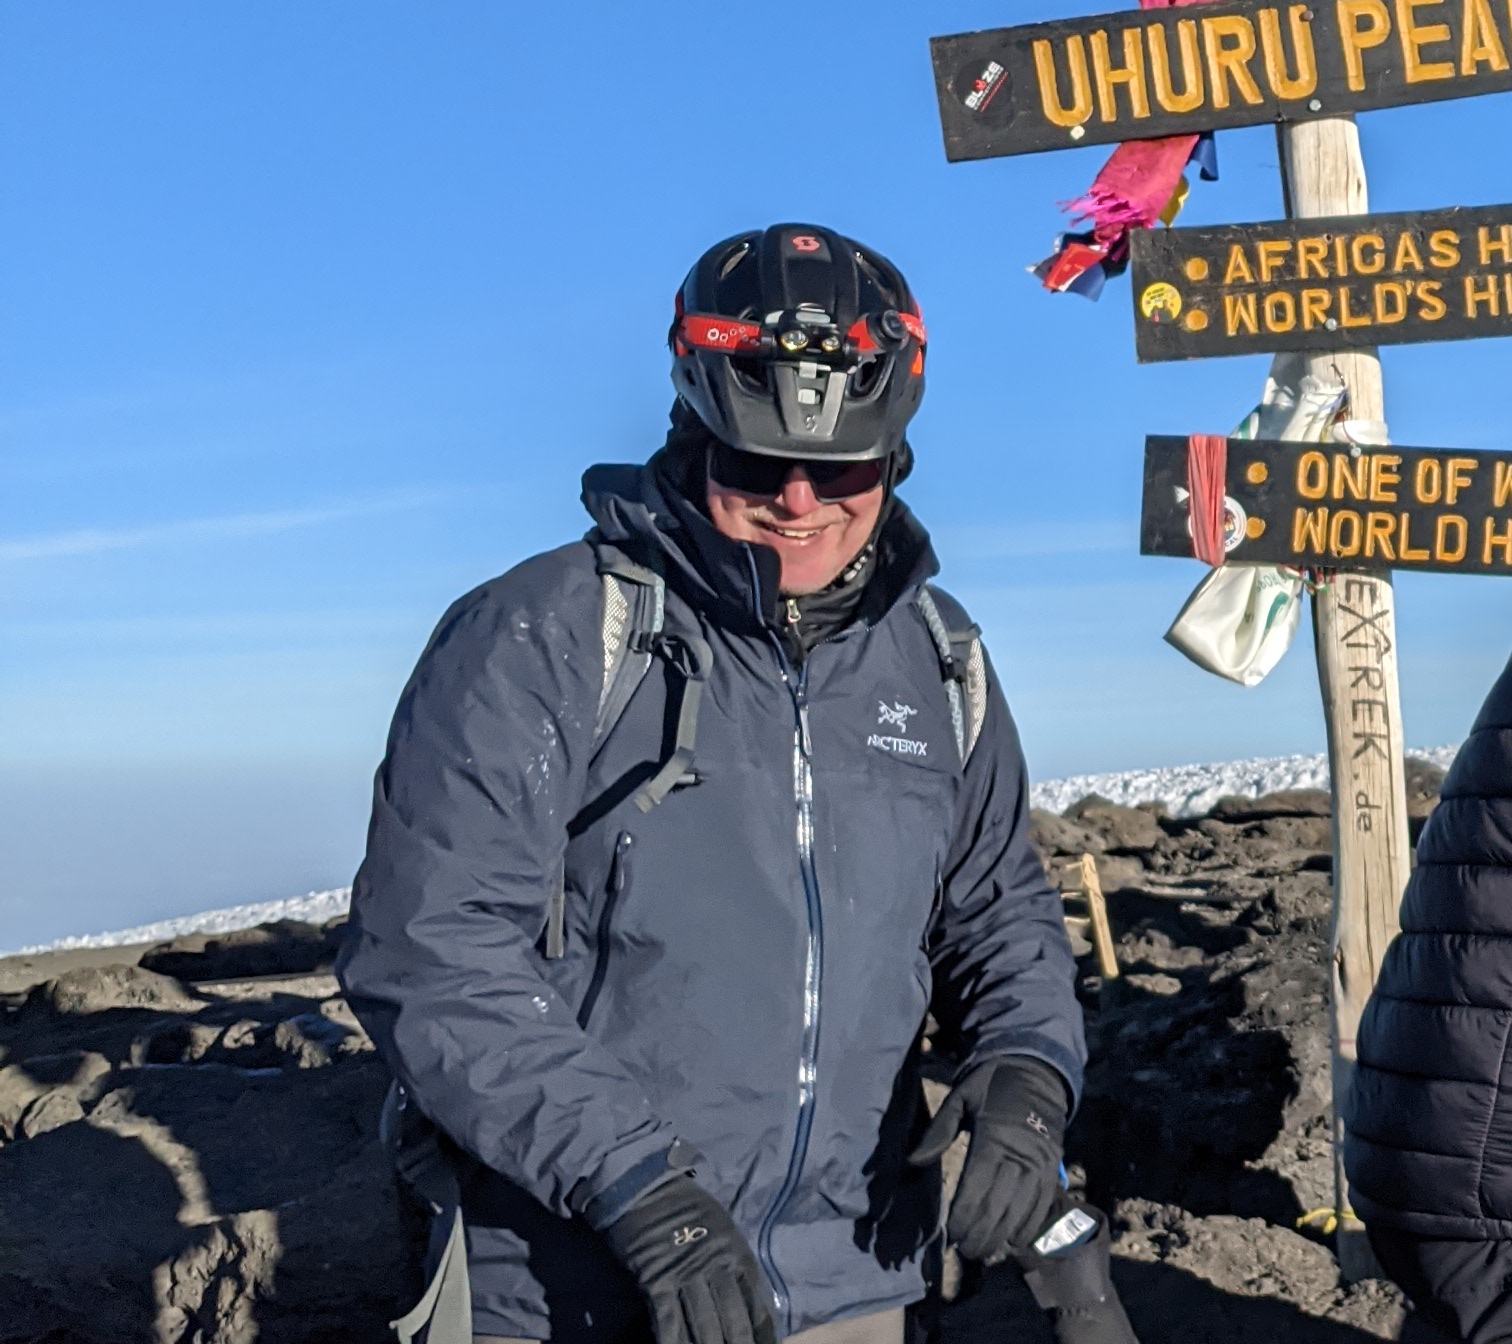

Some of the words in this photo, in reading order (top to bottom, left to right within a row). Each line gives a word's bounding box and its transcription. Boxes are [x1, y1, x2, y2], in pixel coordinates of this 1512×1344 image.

[1033, 5, 1317, 128] UHURU
[1224, 230, 1460, 284] AFRICAS
[1224, 280, 1446, 334] WORLD'S
[1297, 452, 1400, 502] ONE
[1416, 459, 1477, 504] OF
[1293, 508, 1467, 562] WORLD
